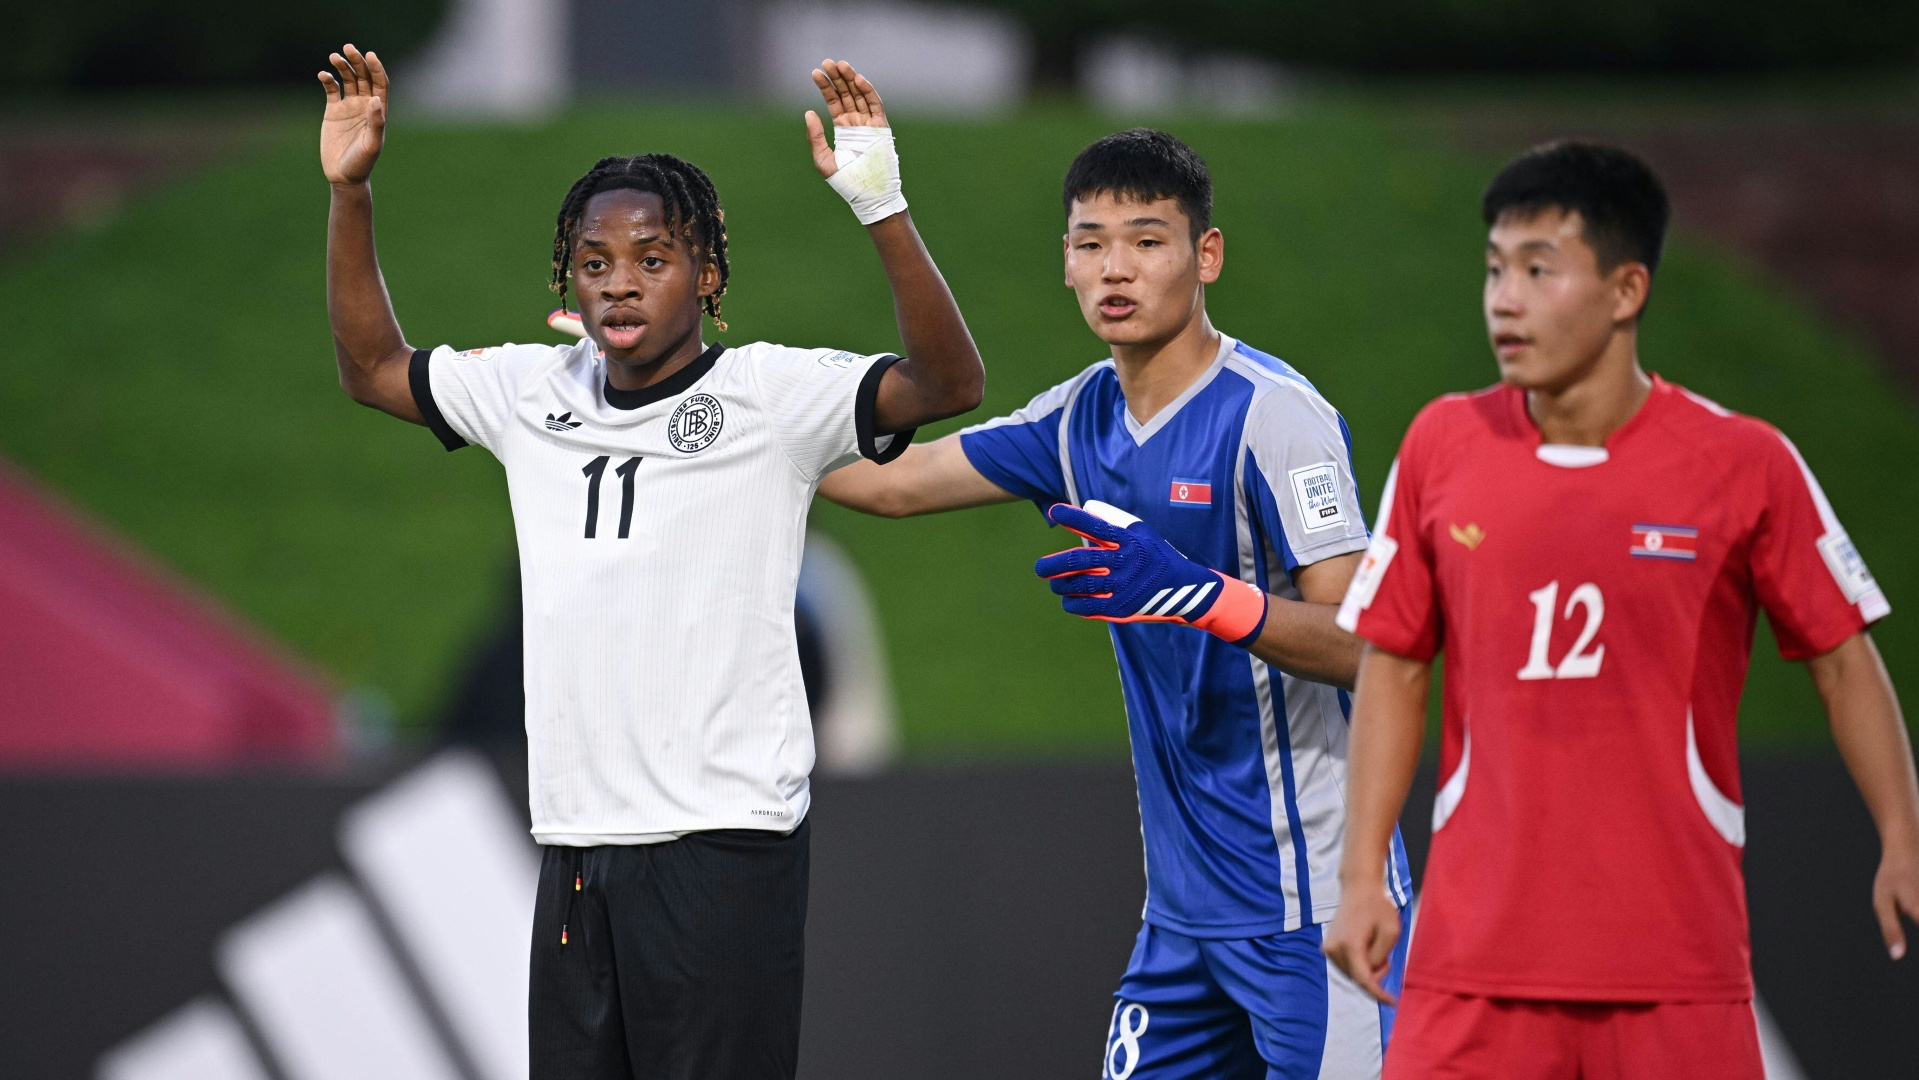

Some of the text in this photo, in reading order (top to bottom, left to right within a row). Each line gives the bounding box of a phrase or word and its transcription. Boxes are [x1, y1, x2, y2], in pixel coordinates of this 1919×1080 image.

[671, 403, 687, 447] DEUTSCHER
[581, 455, 644, 539] 11
[1308, 499, 1320, 509] the
[1321, 507, 1336, 517] FIFA
[1516, 579, 1605, 680] 12
